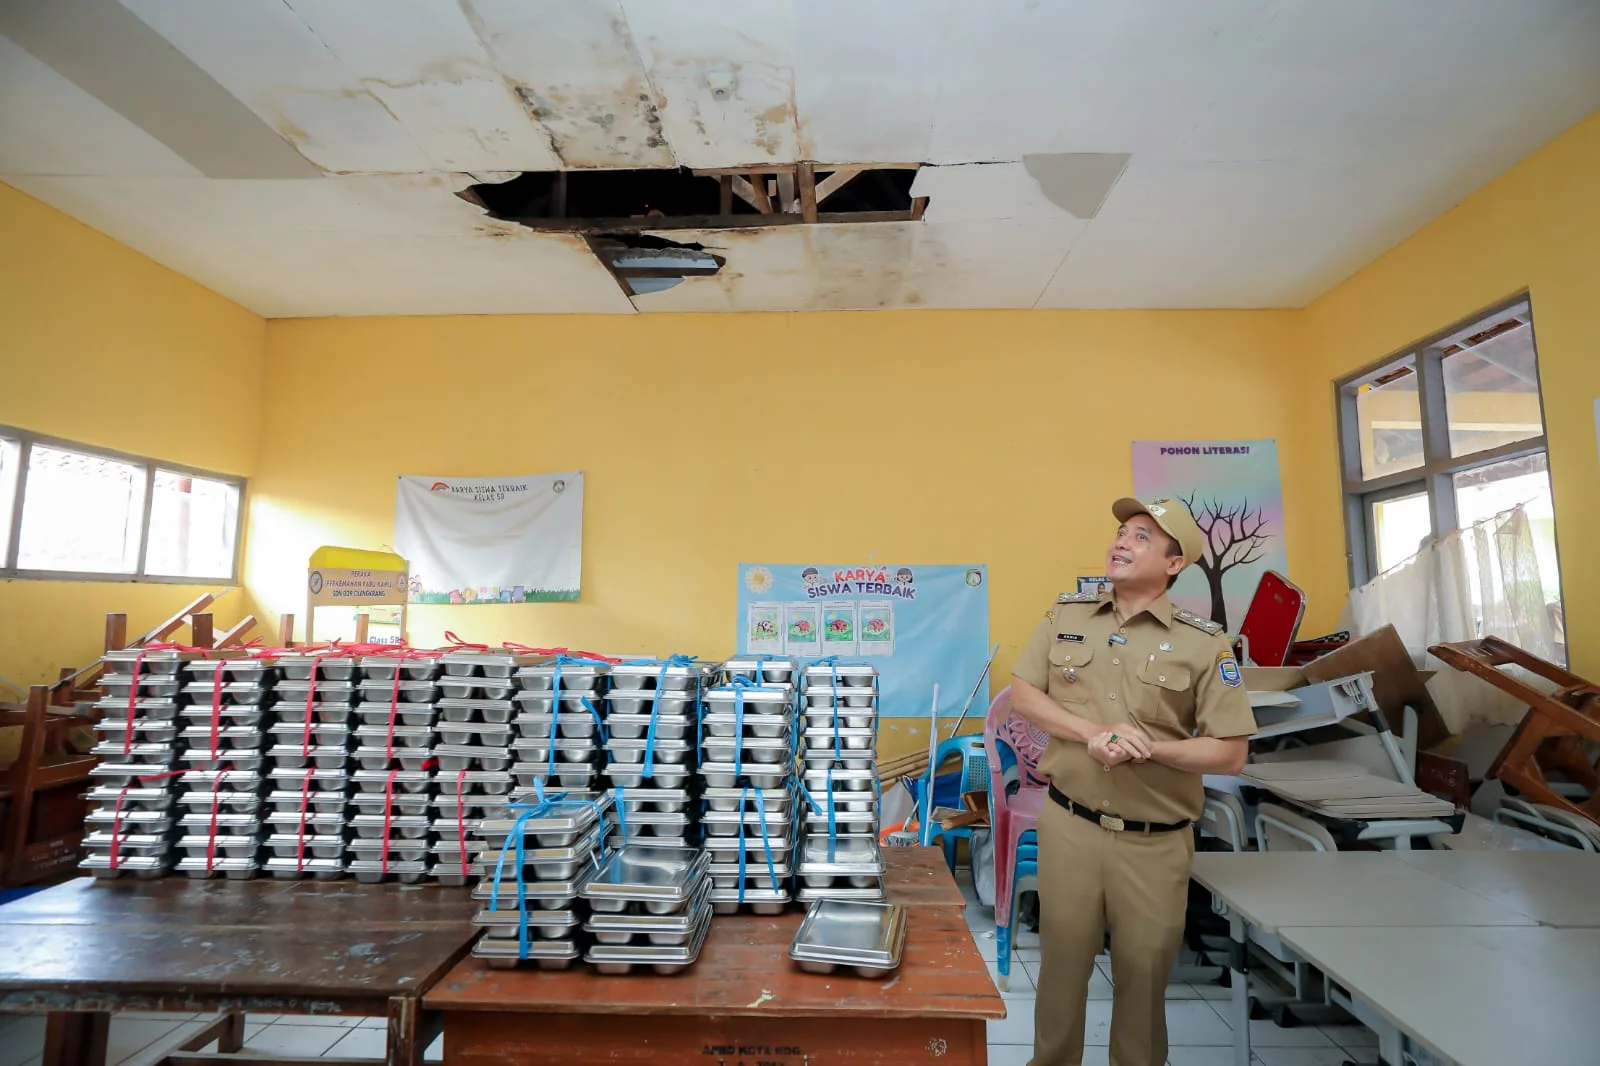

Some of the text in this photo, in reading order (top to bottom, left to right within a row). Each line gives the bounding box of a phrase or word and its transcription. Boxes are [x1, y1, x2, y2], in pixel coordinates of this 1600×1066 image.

[1160, 446, 1250, 455] POHON LITERASI
[834, 569, 885, 582] KARYA
[807, 582, 916, 599] SISWA TERBAIK
